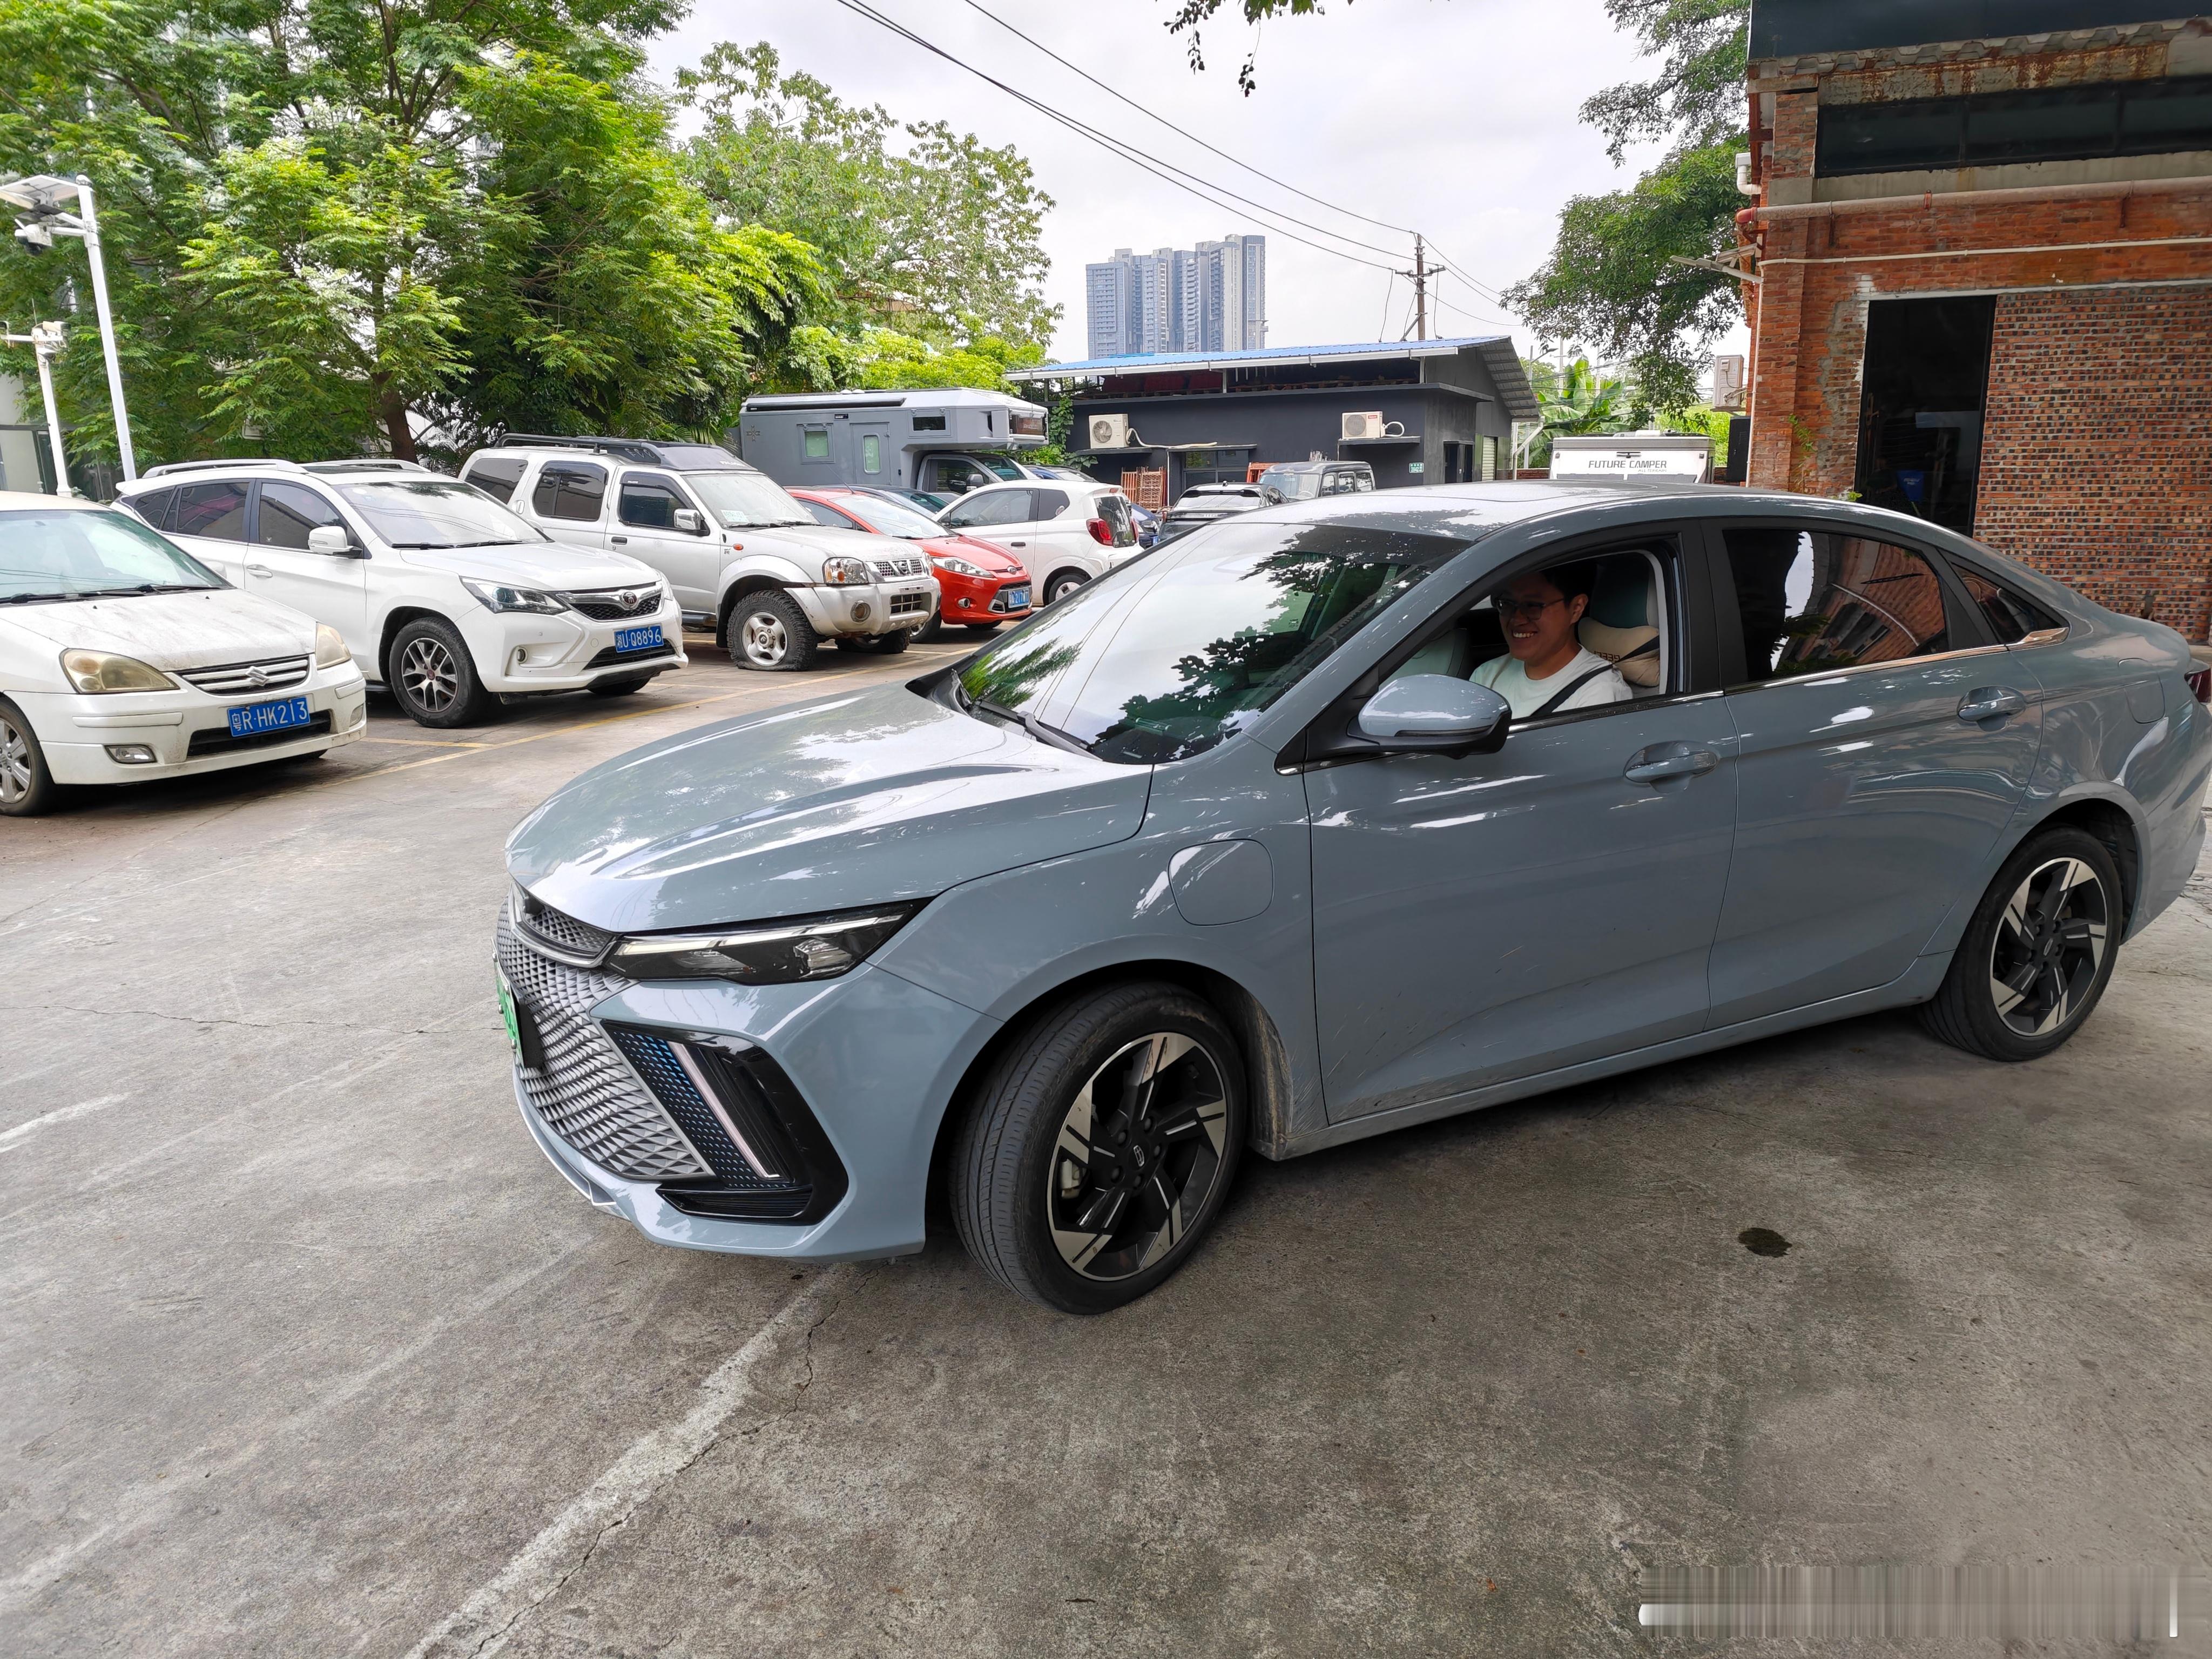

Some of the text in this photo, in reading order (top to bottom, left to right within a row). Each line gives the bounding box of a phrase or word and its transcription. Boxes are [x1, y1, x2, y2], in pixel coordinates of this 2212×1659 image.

[1588, 460, 1667, 468] FUTURE CAMPER
[232, 701, 308, 731] 粤R·HK213
